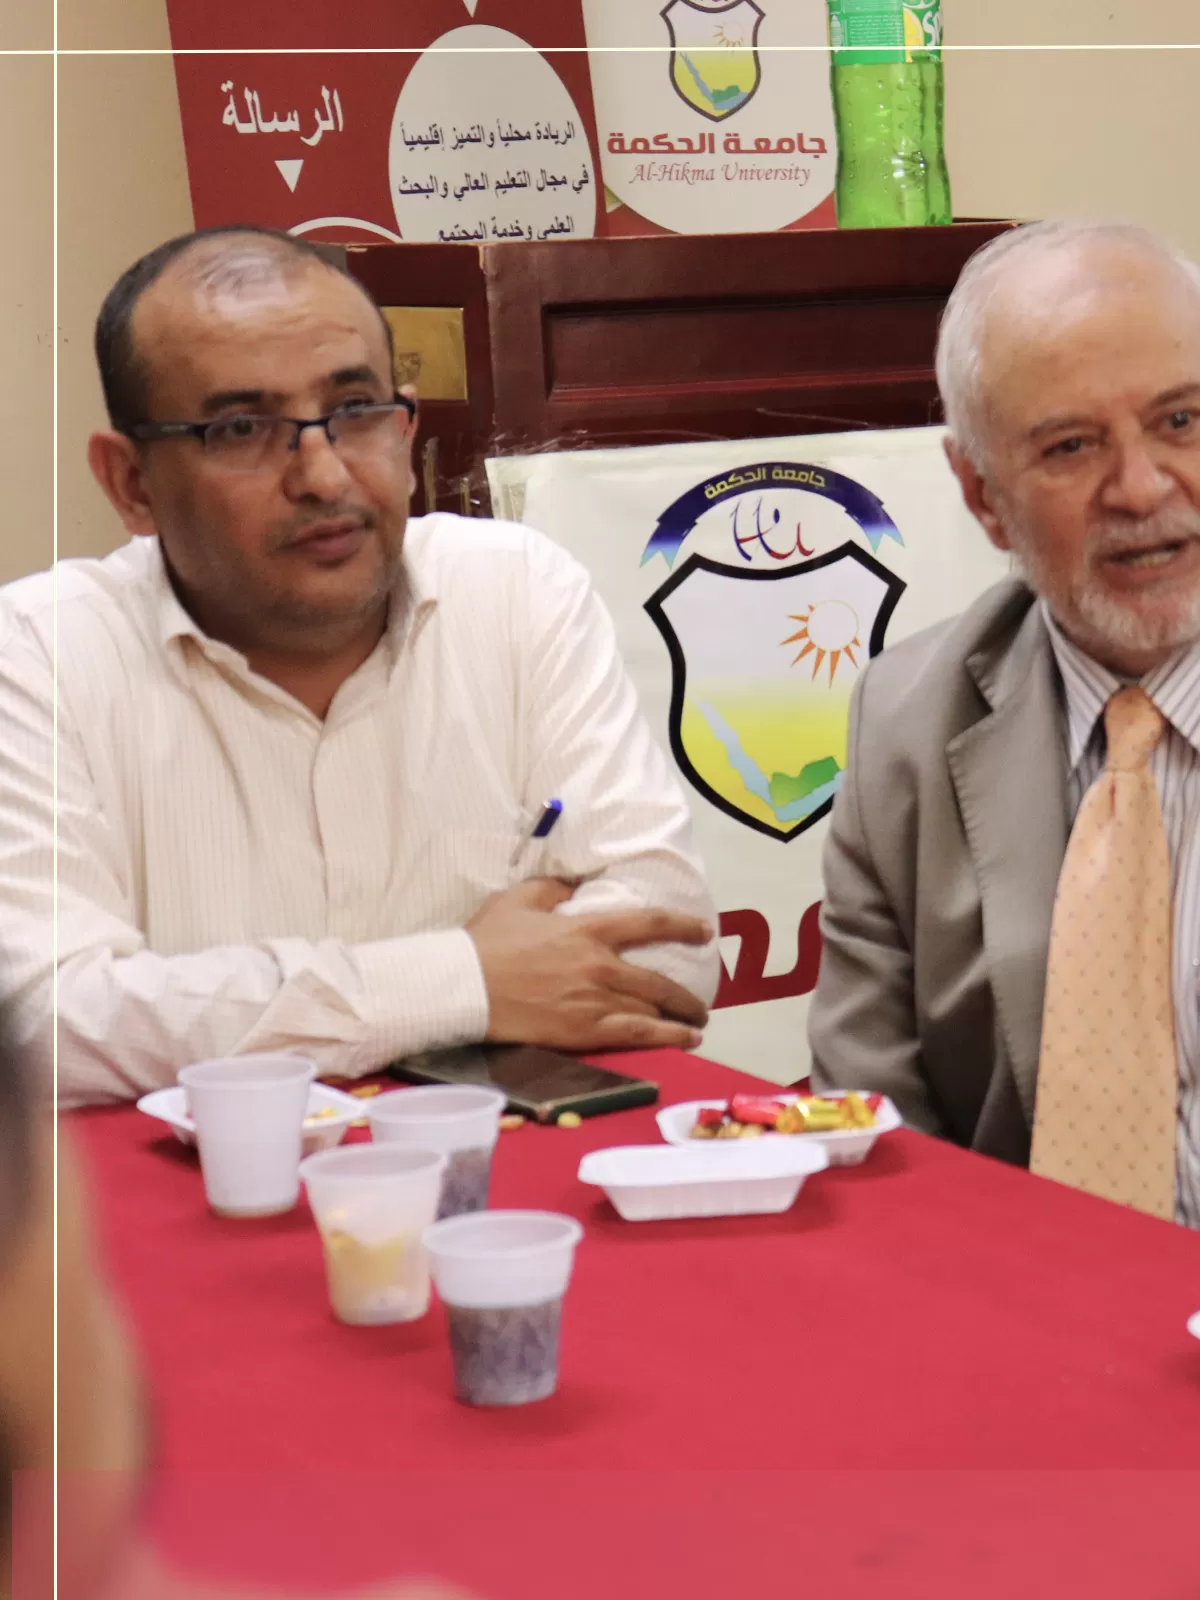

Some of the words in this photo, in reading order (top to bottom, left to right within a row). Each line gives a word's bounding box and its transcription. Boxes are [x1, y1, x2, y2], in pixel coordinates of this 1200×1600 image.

[221, 80, 343, 146] الرسالة
[452, 125, 495, 150] والتميز
[536, 120, 575, 145] الريادة
[607, 132, 715, 154] الحكمة
[723, 133, 828, 158] جامعة
[494, 169, 531, 199] التعليم
[536, 168, 567, 191] مجال
[572, 163, 589, 194] في
[628, 161, 715, 186] Al-Hikma
[721, 162, 811, 186] University
[399, 174, 448, 200] والبحث
[454, 172, 489, 201] العالي
[491, 216, 532, 241] وخدمة
[704, 467, 766, 499] الحكمة
[772, 466, 825, 489] جامعة
